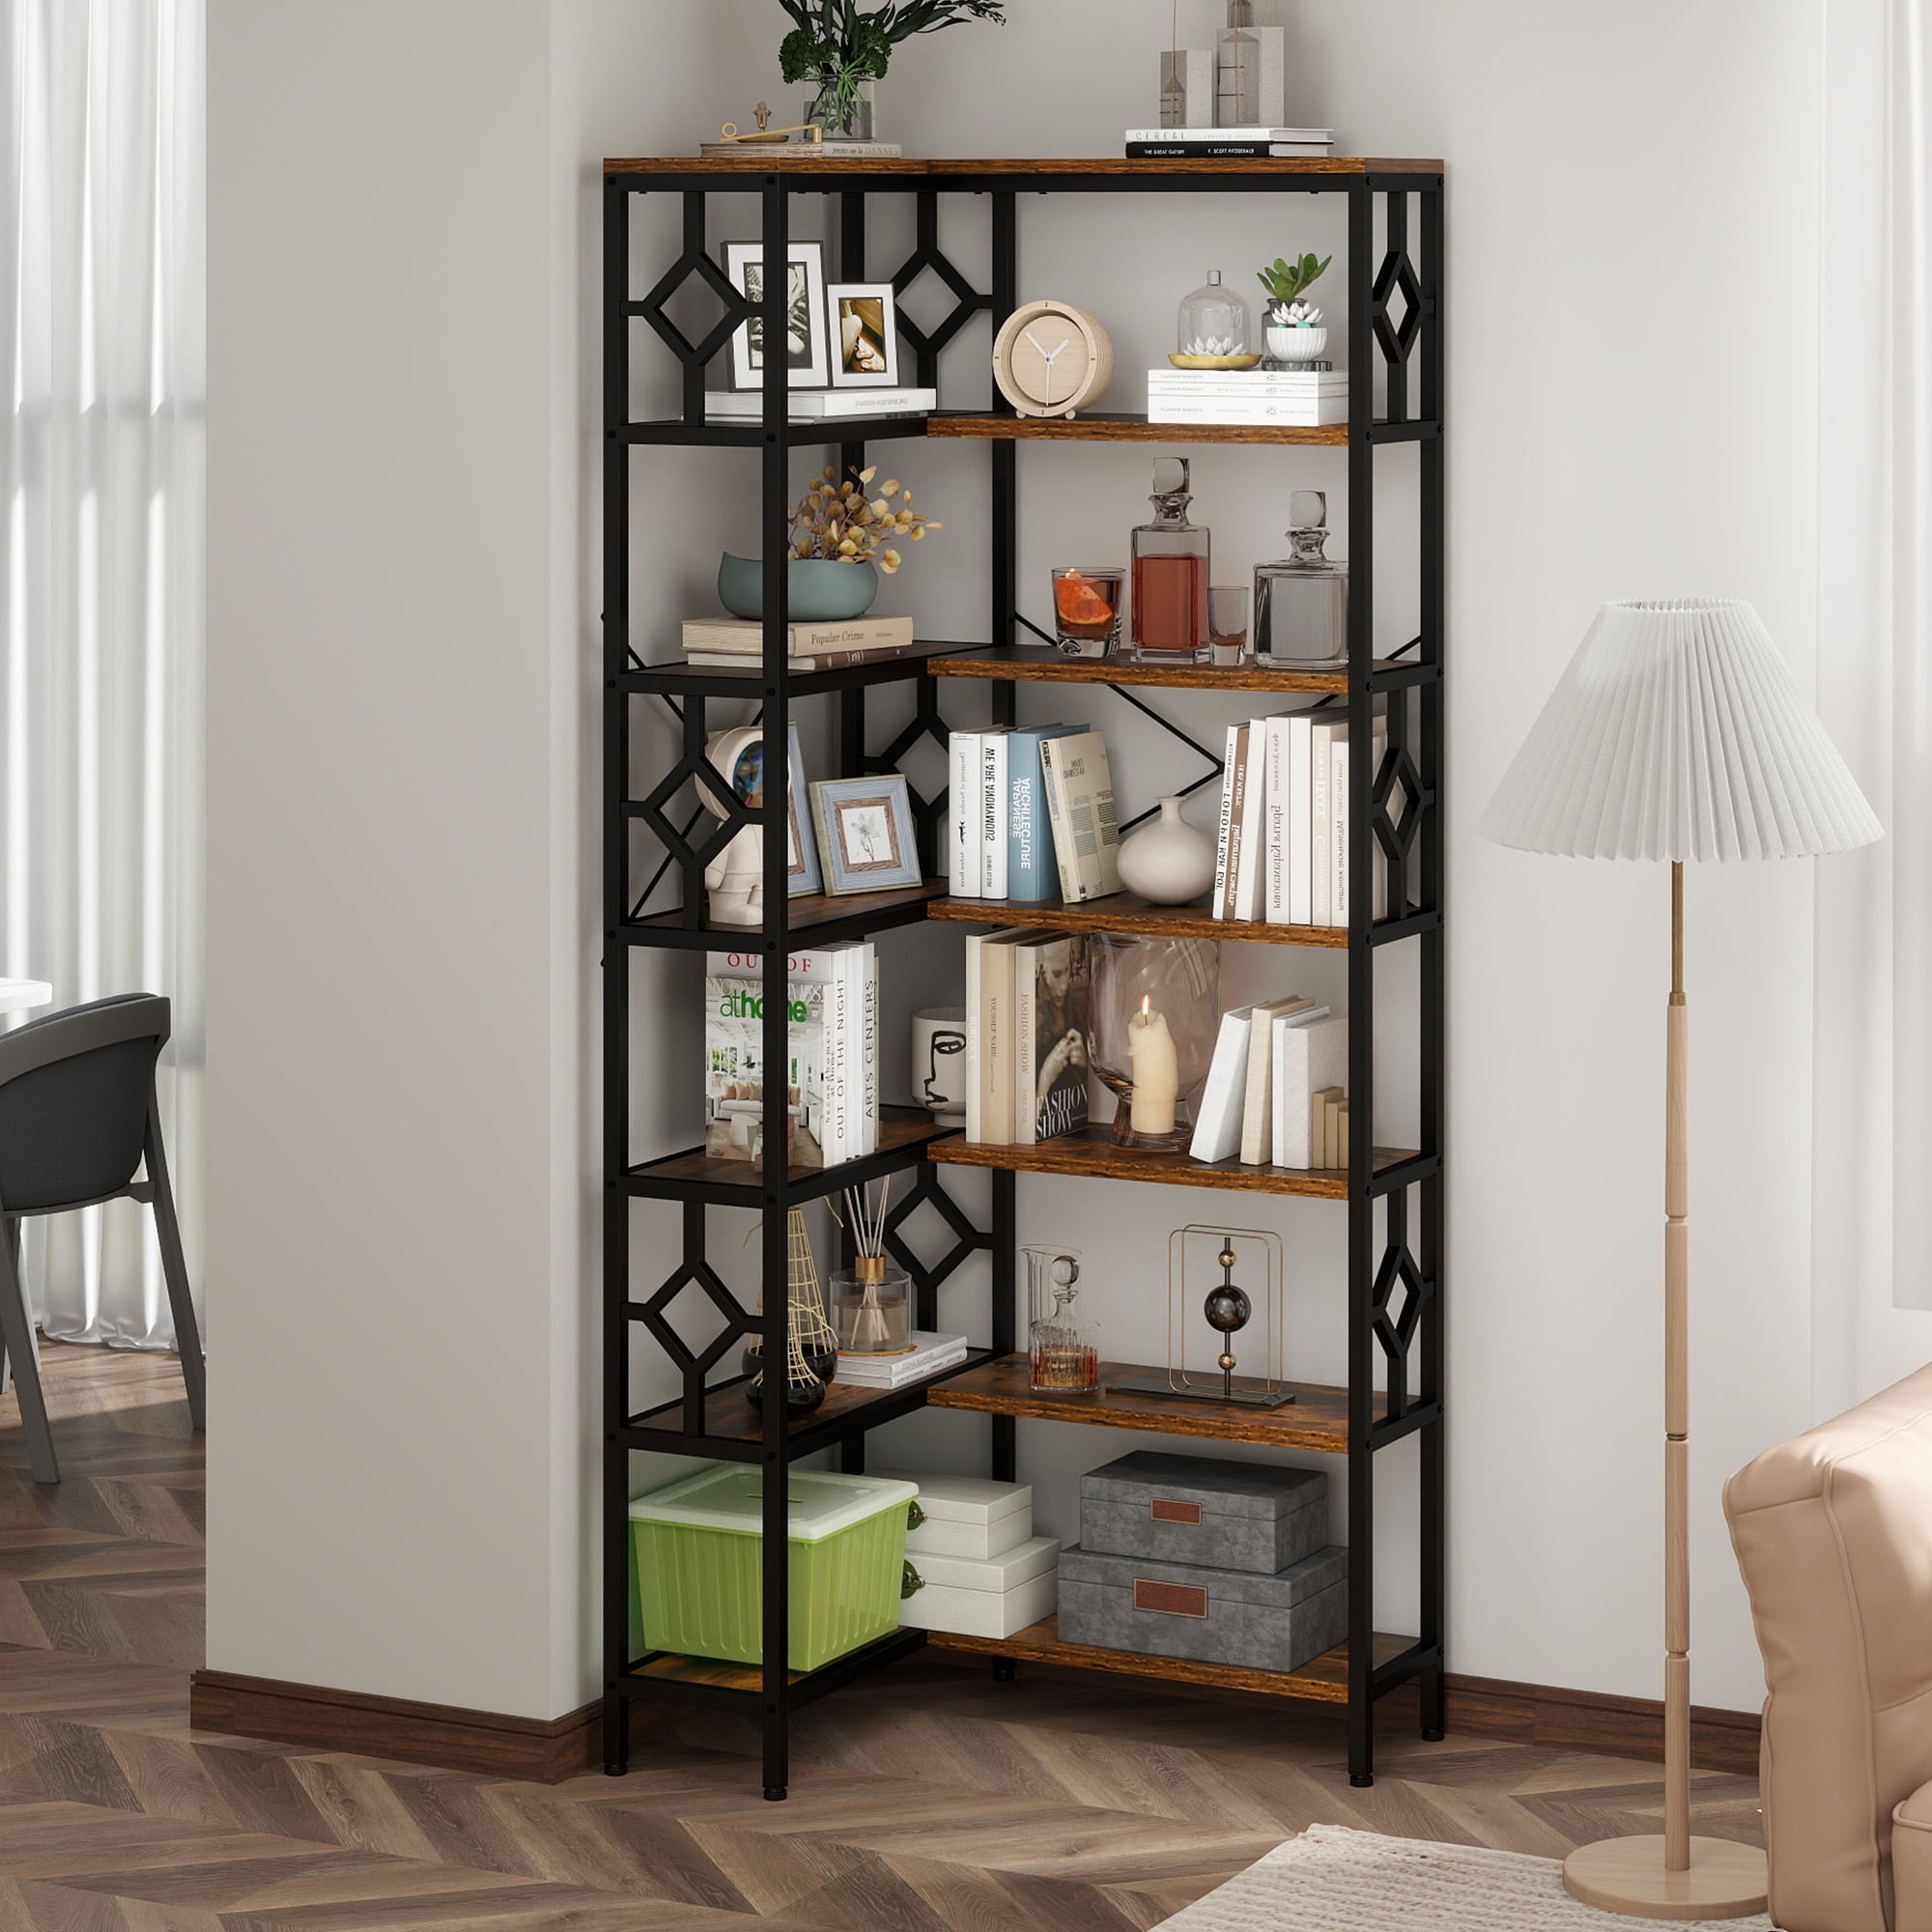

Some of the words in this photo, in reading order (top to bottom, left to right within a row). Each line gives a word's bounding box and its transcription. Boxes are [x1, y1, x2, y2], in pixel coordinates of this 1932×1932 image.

[1136, 131, 1185, 140] CEREAL
[811, 634, 840, 645] Popular
[842, 630, 866, 642] Crime
[1020, 993, 1029, 1039] FASHION
[1020, 1041, 1029, 1074] SHOW
[837, 1078, 844, 1098] OF
[1037, 1083, 1088, 1119] FASHION
[1036, 1109, 1072, 1140] SHOW
